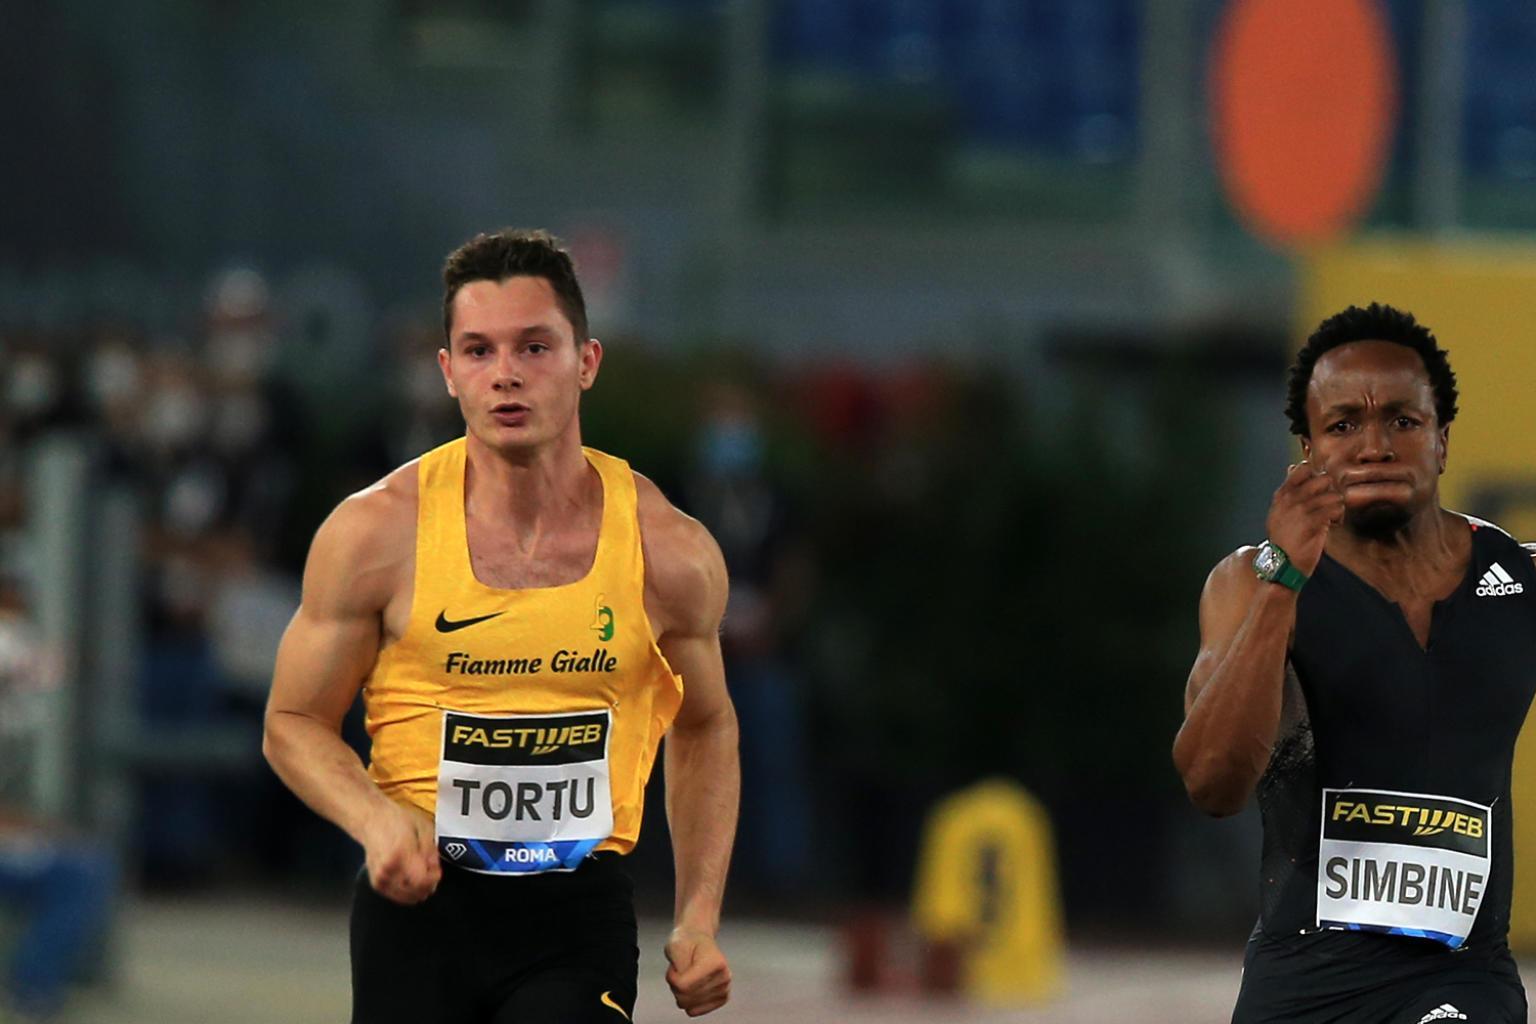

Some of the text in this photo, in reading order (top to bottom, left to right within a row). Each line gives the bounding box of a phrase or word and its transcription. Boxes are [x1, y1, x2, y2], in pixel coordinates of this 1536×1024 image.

[1476, 583, 1523, 597] adidas
[446, 649, 617, 675] Fiamme Gialle
[452, 724, 601, 755] FASTWEB
[453, 777, 595, 821] TORTU
[1332, 802, 1484, 836] FASTWEB
[505, 848, 557, 863] ROMA
[1325, 857, 1484, 915] SIMBINE
